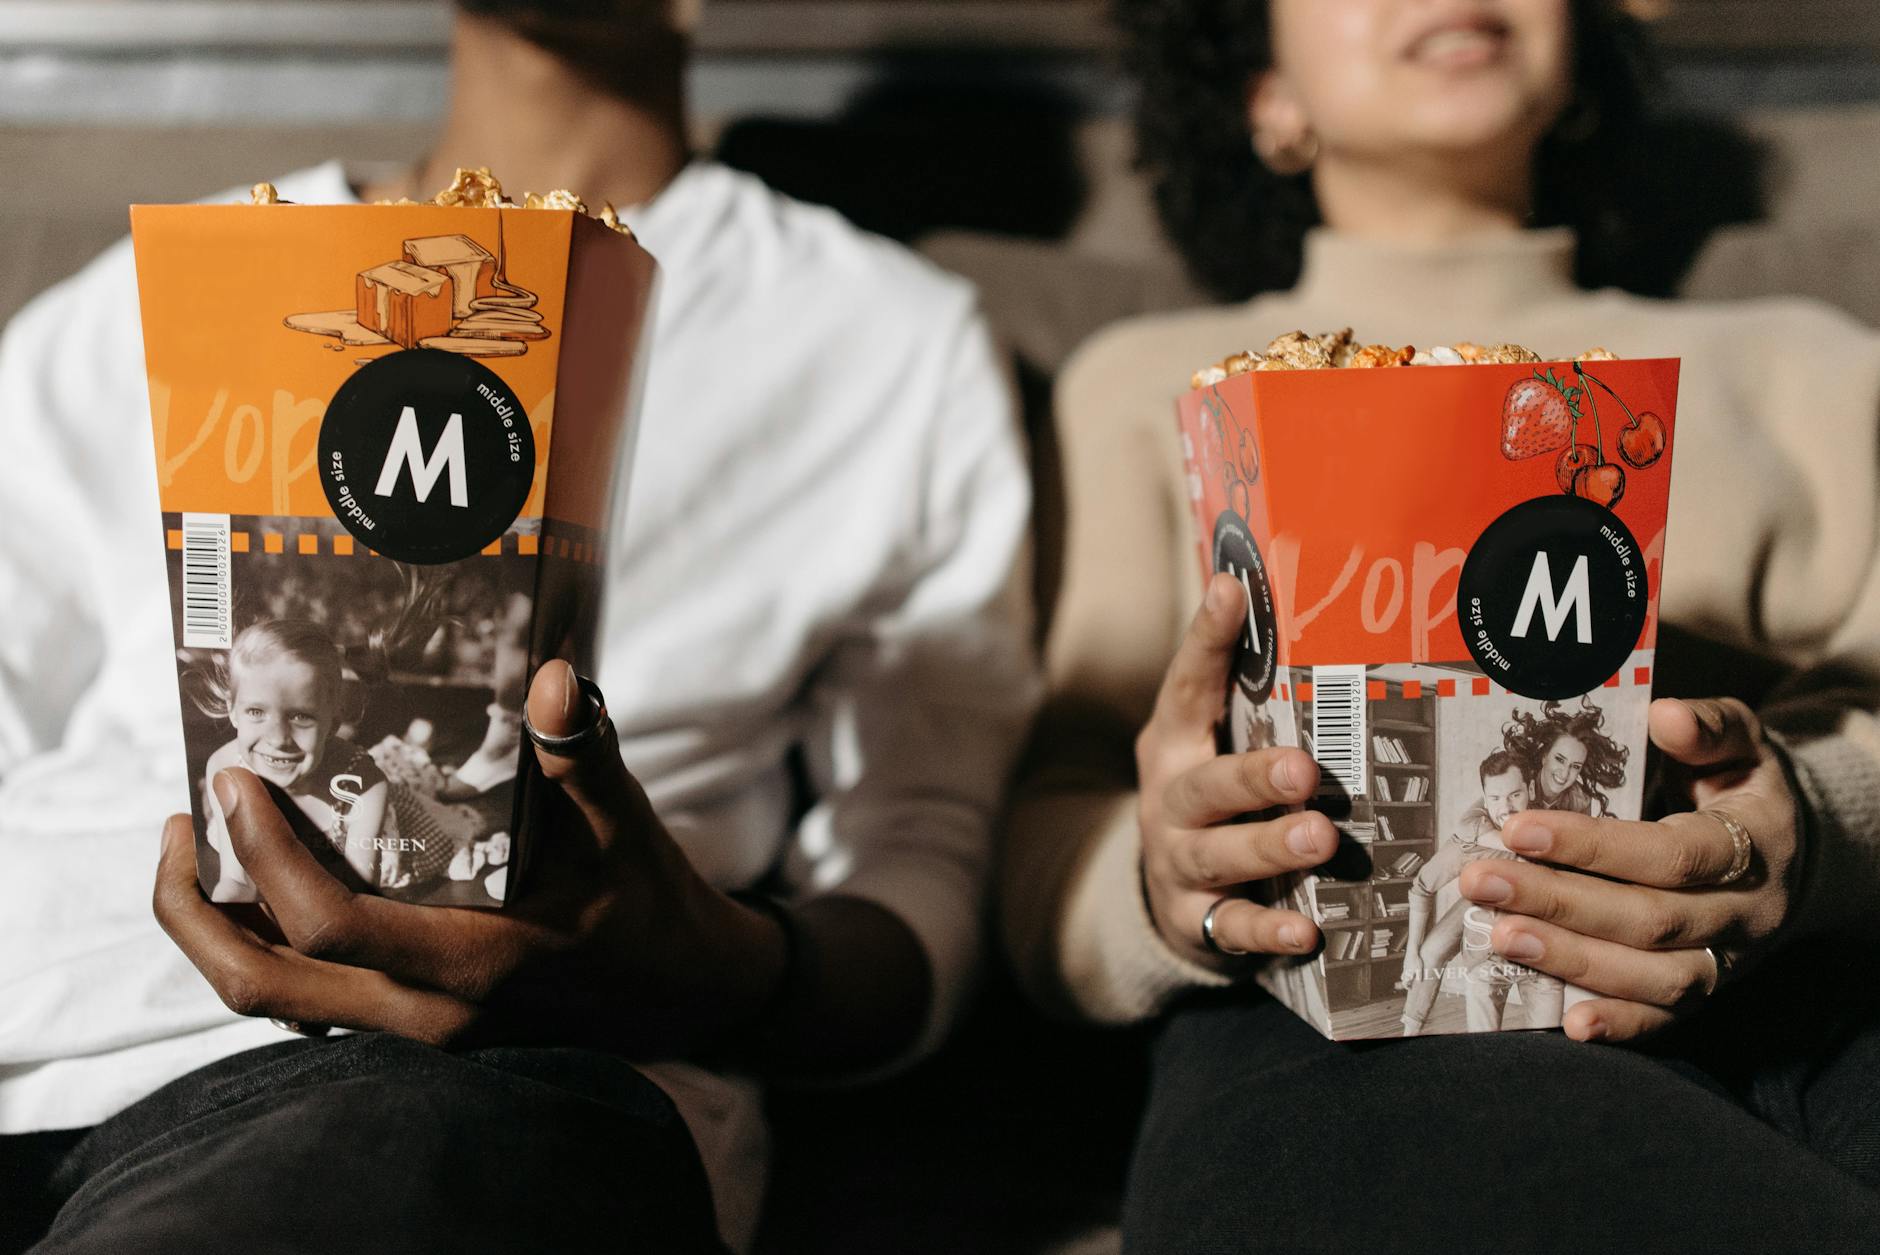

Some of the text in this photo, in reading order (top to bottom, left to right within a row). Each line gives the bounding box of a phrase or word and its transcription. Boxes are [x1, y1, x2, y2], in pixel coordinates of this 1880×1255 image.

[374, 405, 469, 508] M
[477, 383, 523, 463] middle size
[331, 450, 377, 531] middle size
[1510, 550, 1593, 644] M
[1600, 524, 1638, 599] middle size
[1470, 596, 1512, 672] middle size
[348, 837, 426, 852] SCREEN
[1402, 967, 1476, 983] SILVER
